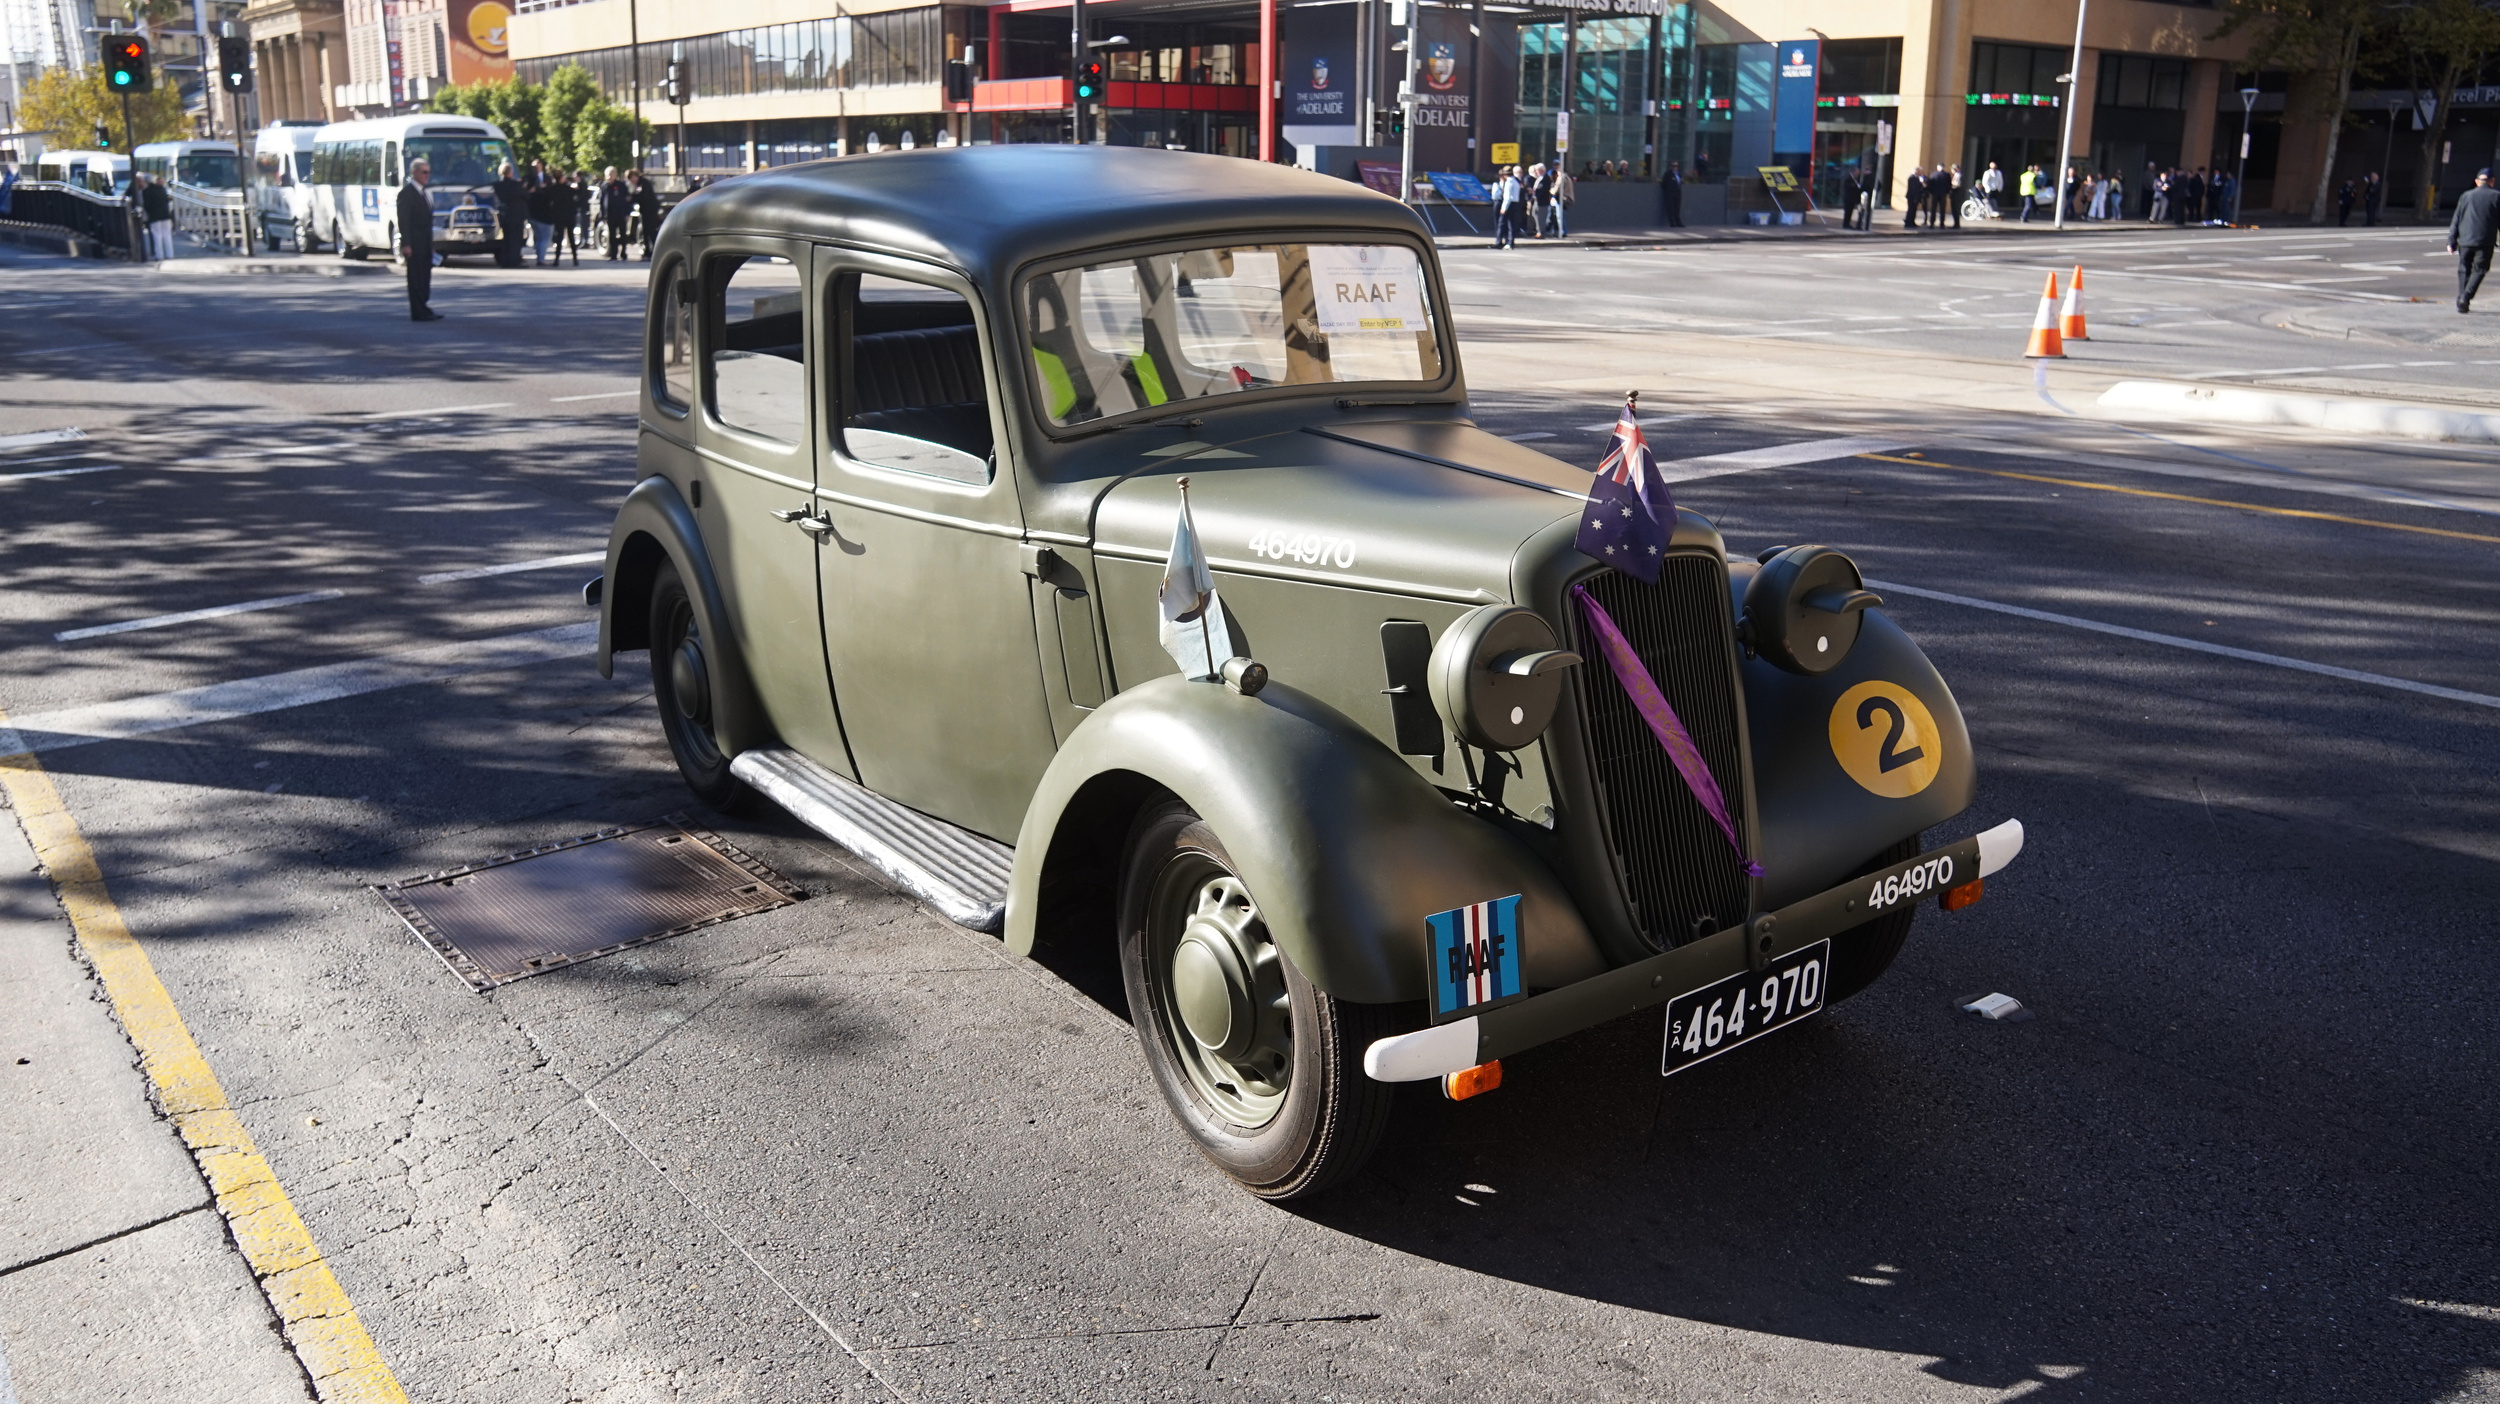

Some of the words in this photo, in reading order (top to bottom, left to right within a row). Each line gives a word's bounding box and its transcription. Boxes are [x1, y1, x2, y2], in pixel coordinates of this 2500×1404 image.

[1613, 0, 1668, 16] School
[1297, 92, 1308, 101] THE
[1309, 91, 1343, 101] UNIVERSITY
[1302, 102, 1344, 115] ADELAIDE
[1335, 283, 1397, 303] RAAF
[1376, 320, 1384, 328] by
[1248, 528, 1357, 569] 464970
[1635, 675, 1659, 711] WE
[1654, 708, 1701, 776] FORGET
[1856, 695, 1925, 774] 2
[1867, 855, 1954, 910] 464970
[1447, 934, 1505, 984] RAAF
